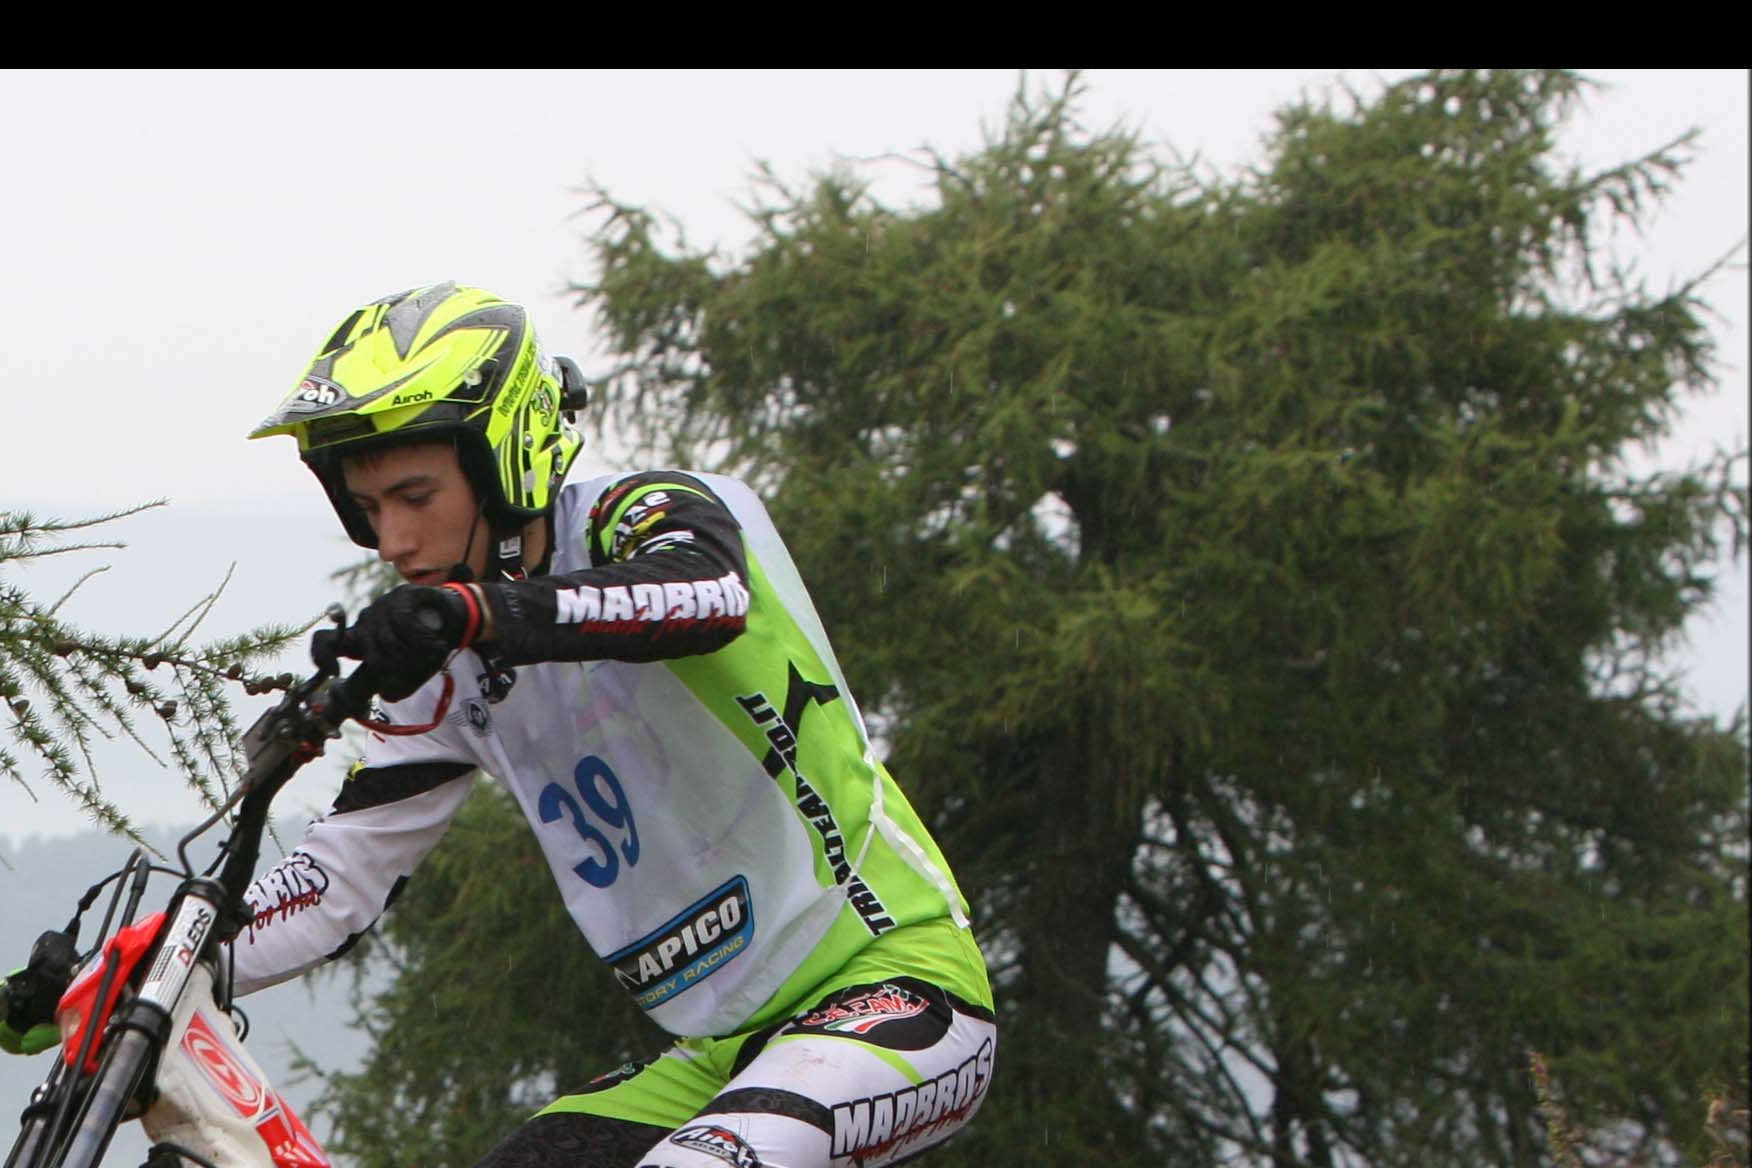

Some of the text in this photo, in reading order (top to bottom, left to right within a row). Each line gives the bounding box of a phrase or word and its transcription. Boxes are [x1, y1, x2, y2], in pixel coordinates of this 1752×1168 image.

[538, 754, 641, 889] 39
[637, 895, 743, 984] APICO
[683, 935, 746, 982] RACING
[830, 1036, 993, 1160] MADBROS
